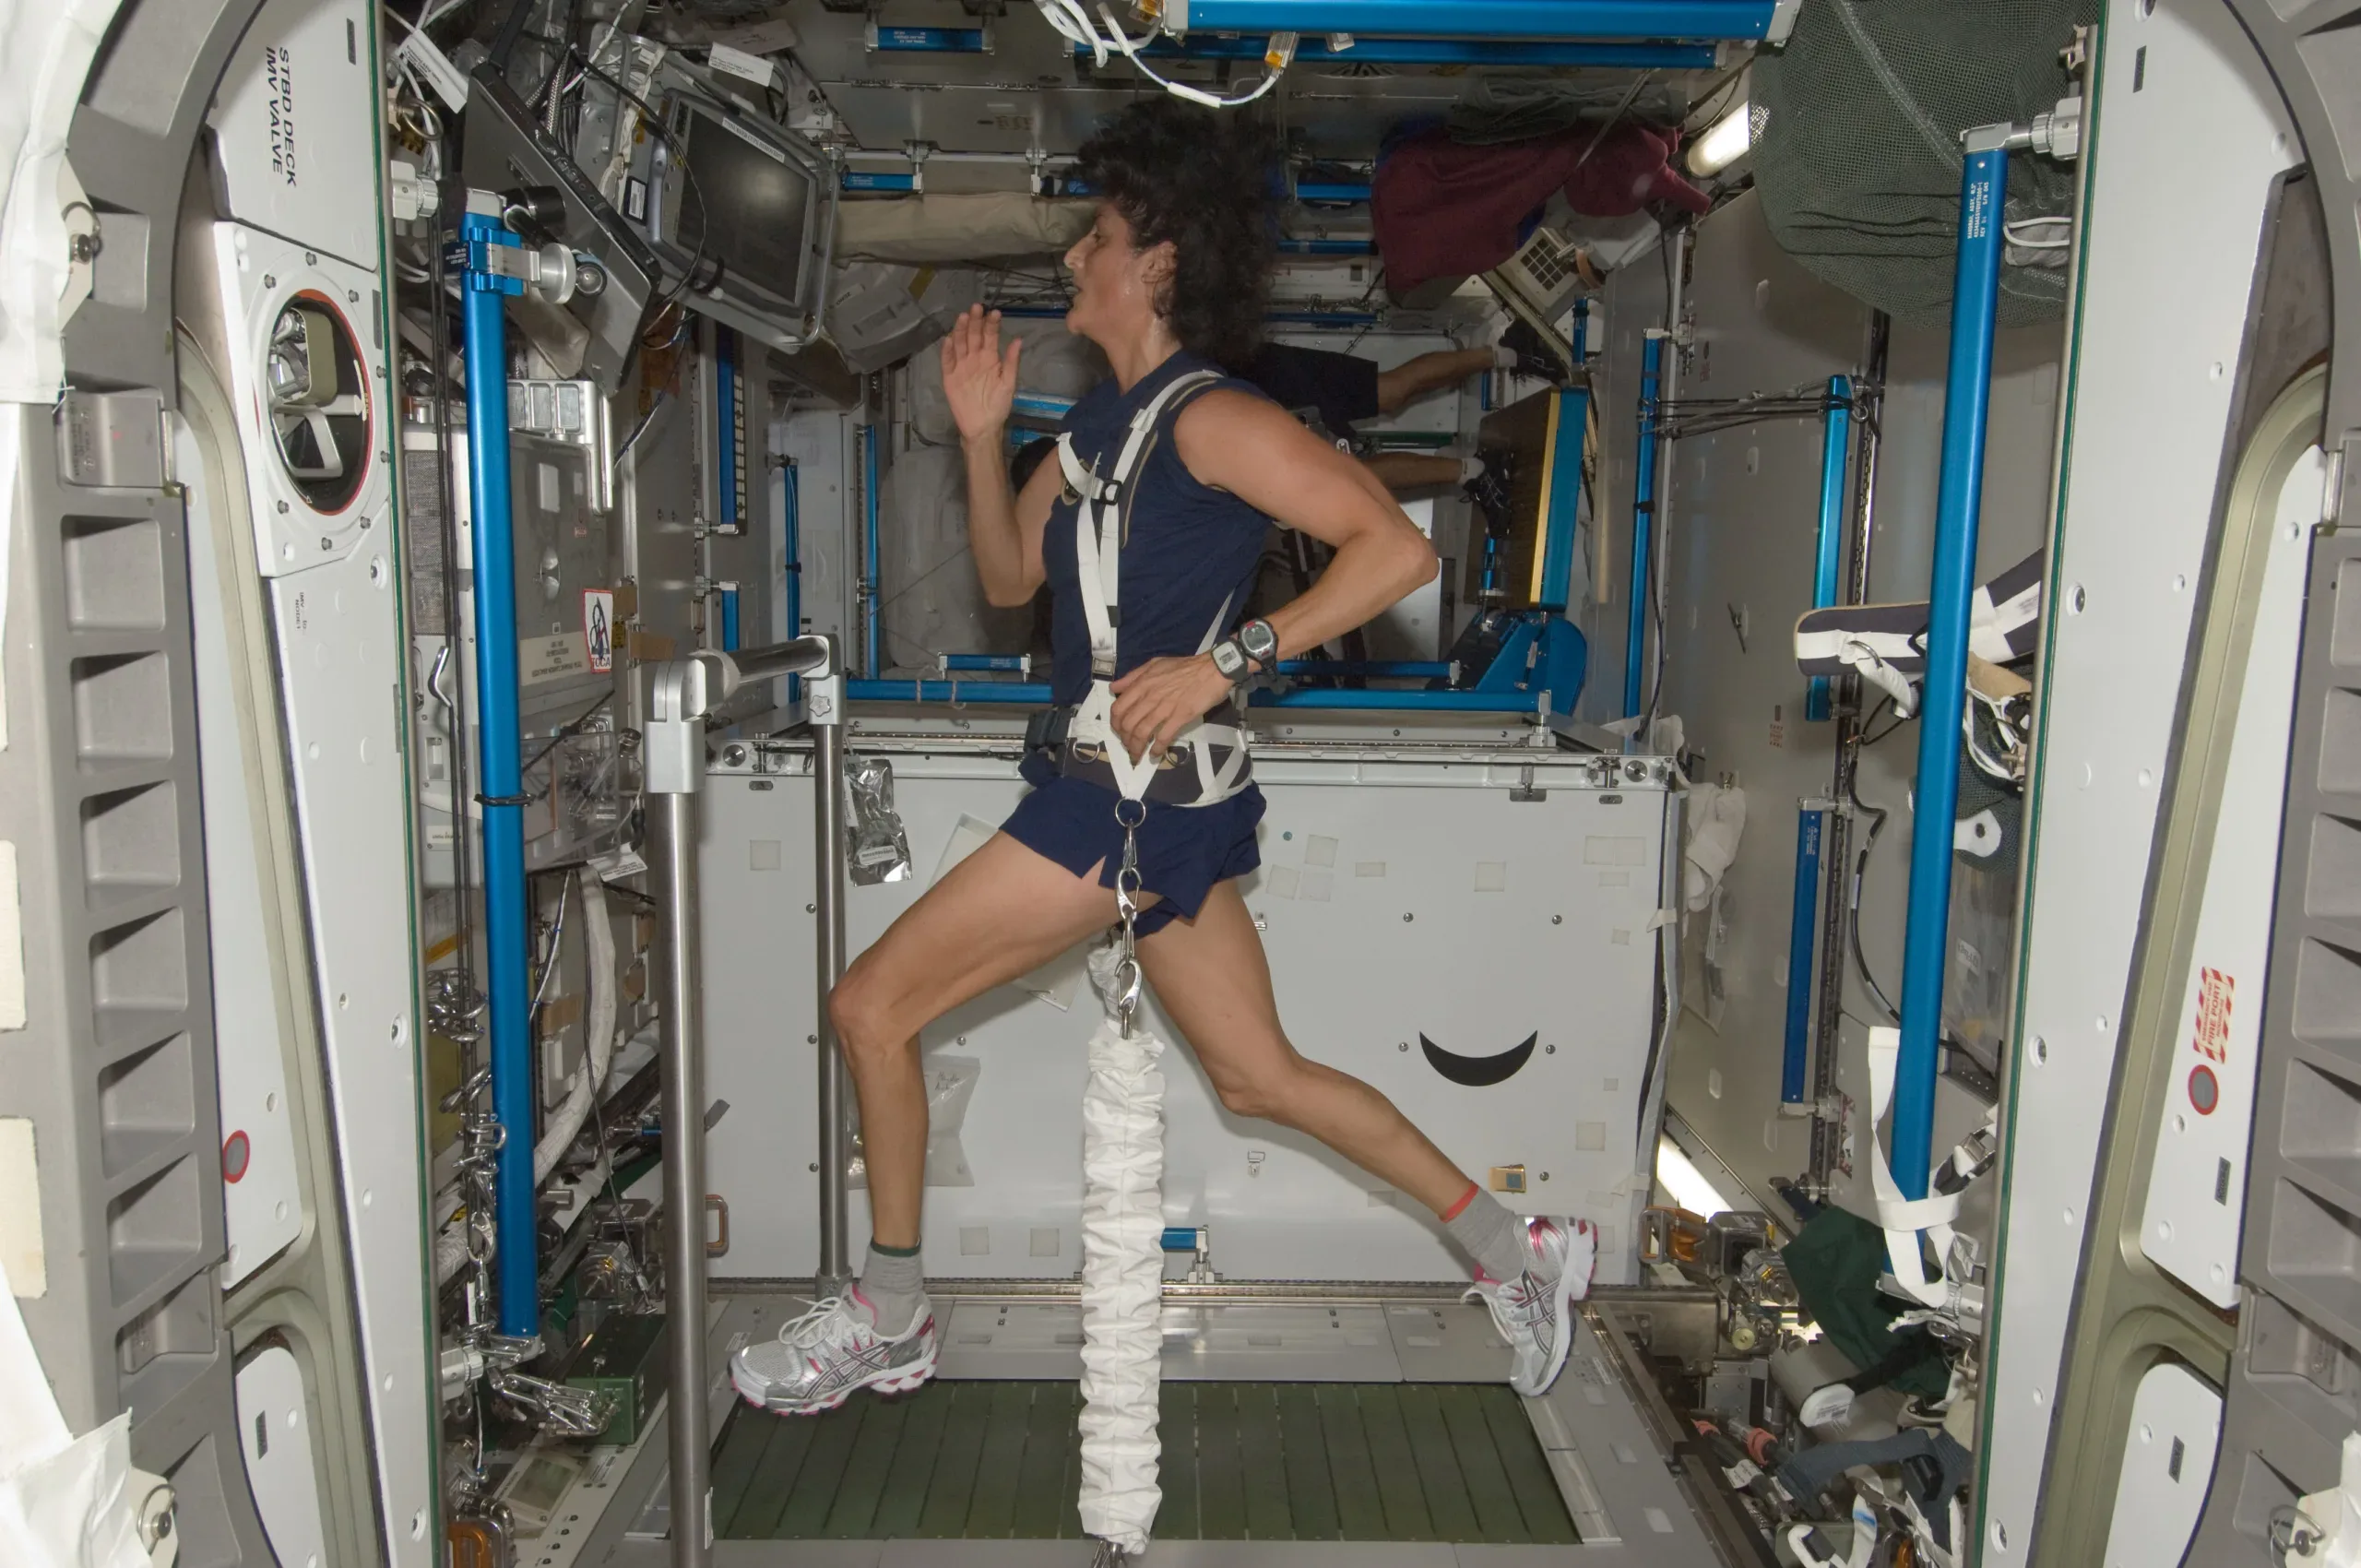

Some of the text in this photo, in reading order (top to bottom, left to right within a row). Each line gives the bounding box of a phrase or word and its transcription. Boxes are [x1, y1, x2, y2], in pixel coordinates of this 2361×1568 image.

[266, 46, 283, 175] IMV VALVE
[279, 46, 297, 187] STBD DECK
[2208, 1018, 2216, 1045] FIRE
[2211, 983, 2220, 1016] PORT
